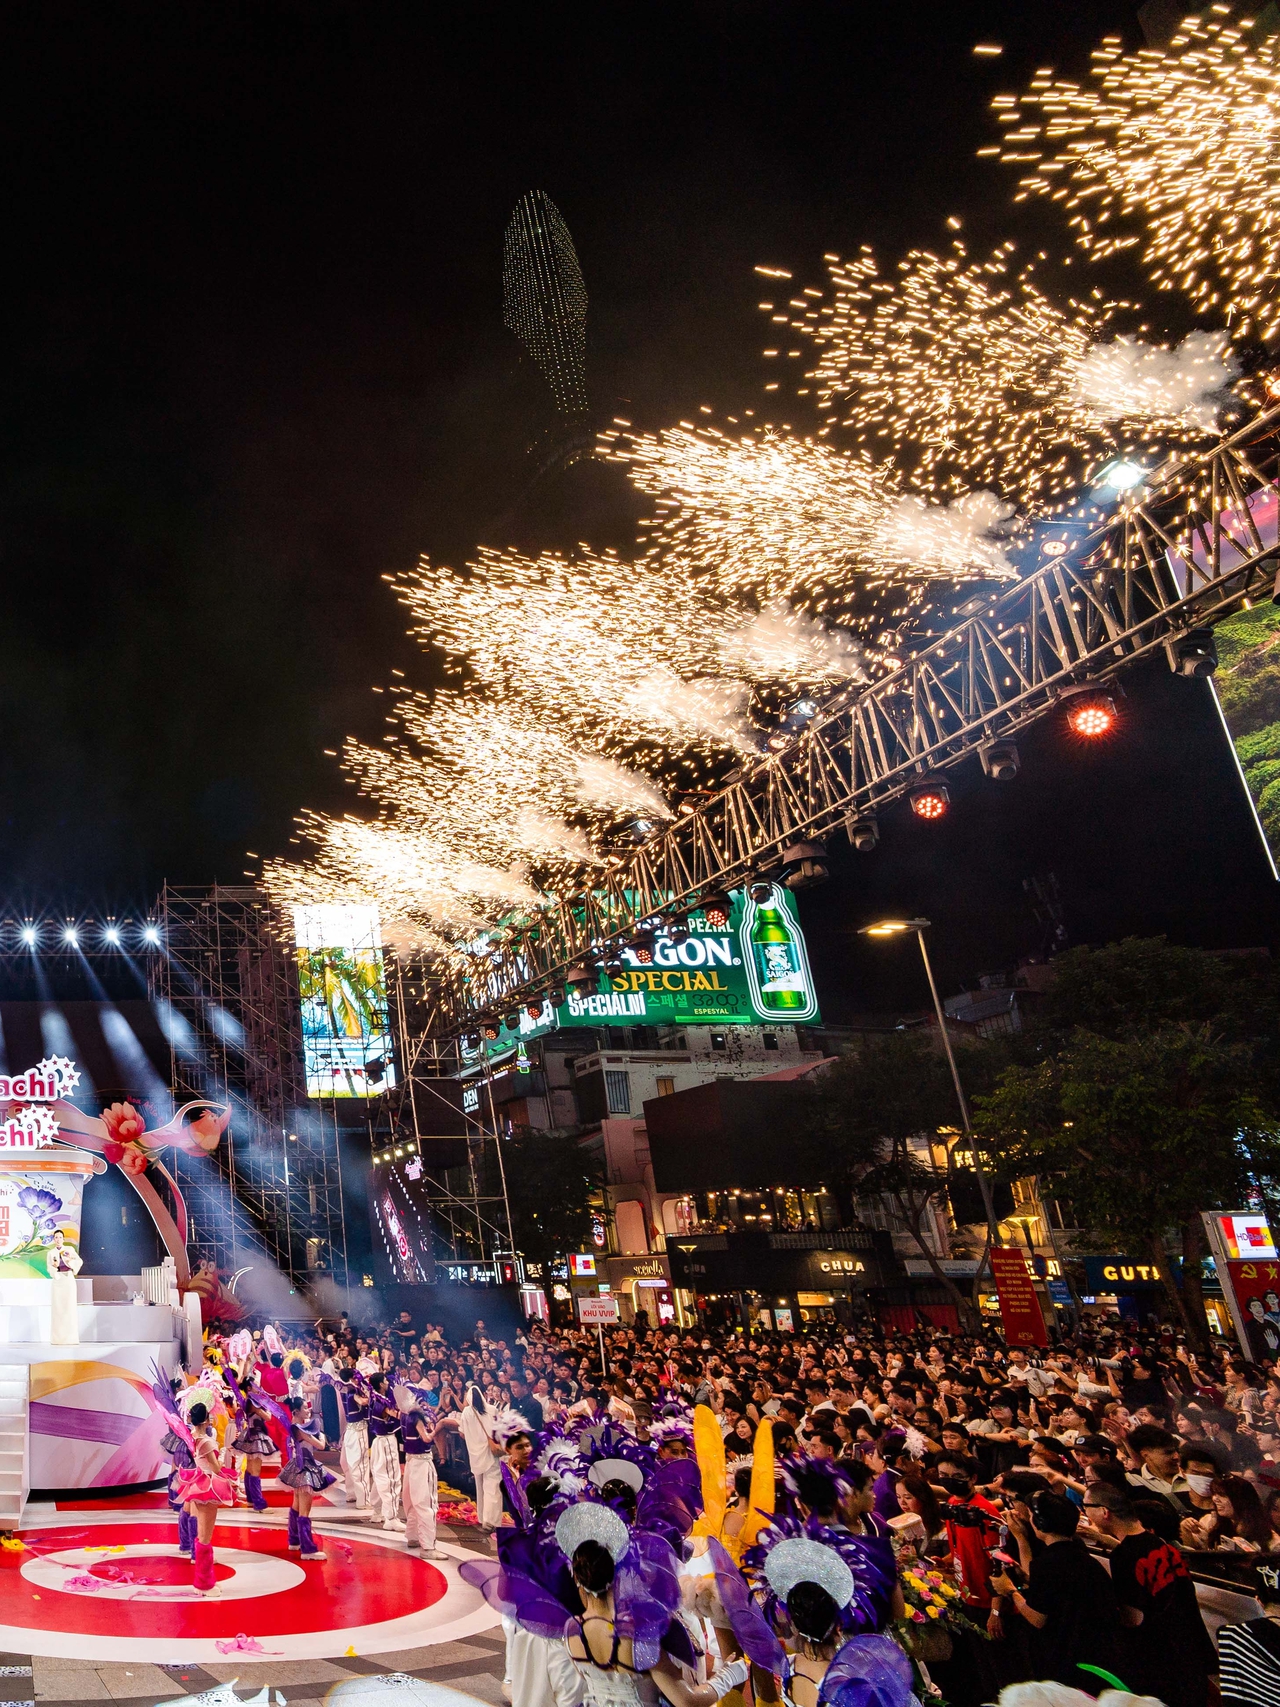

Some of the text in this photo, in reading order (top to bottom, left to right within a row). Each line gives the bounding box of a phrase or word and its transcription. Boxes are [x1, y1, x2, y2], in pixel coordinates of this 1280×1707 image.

[612, 970, 728, 991] SPECIAL
[1236, 1232, 1270, 1241] HDBank
[820, 1260, 866, 1272] CHUA
